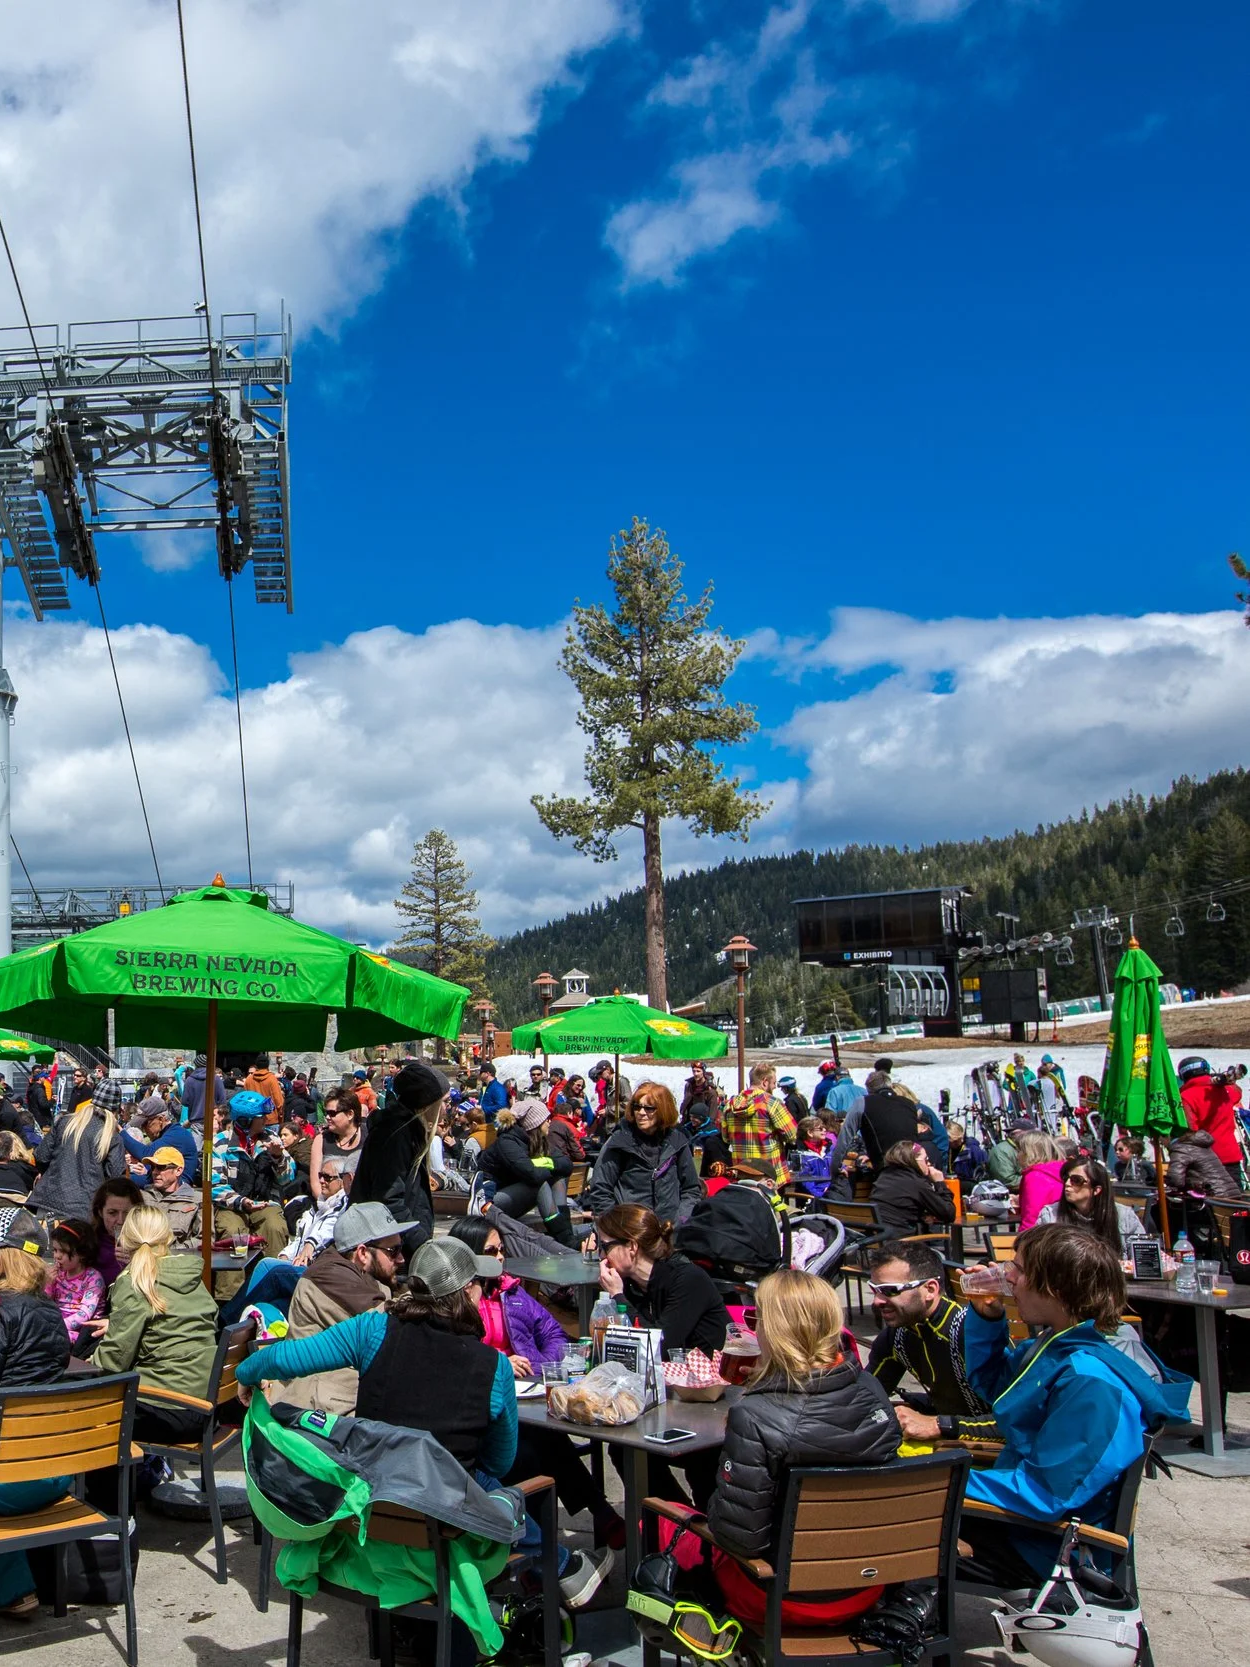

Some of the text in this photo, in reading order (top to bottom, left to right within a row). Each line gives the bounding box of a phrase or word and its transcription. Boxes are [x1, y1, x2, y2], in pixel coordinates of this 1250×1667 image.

[115, 950, 298, 977] SIERRA NEVADA
[133, 973, 281, 999] BREWING CO.
[565, 1044, 605, 1052] BREWING
[593, 1036, 629, 1044] NEVADA
